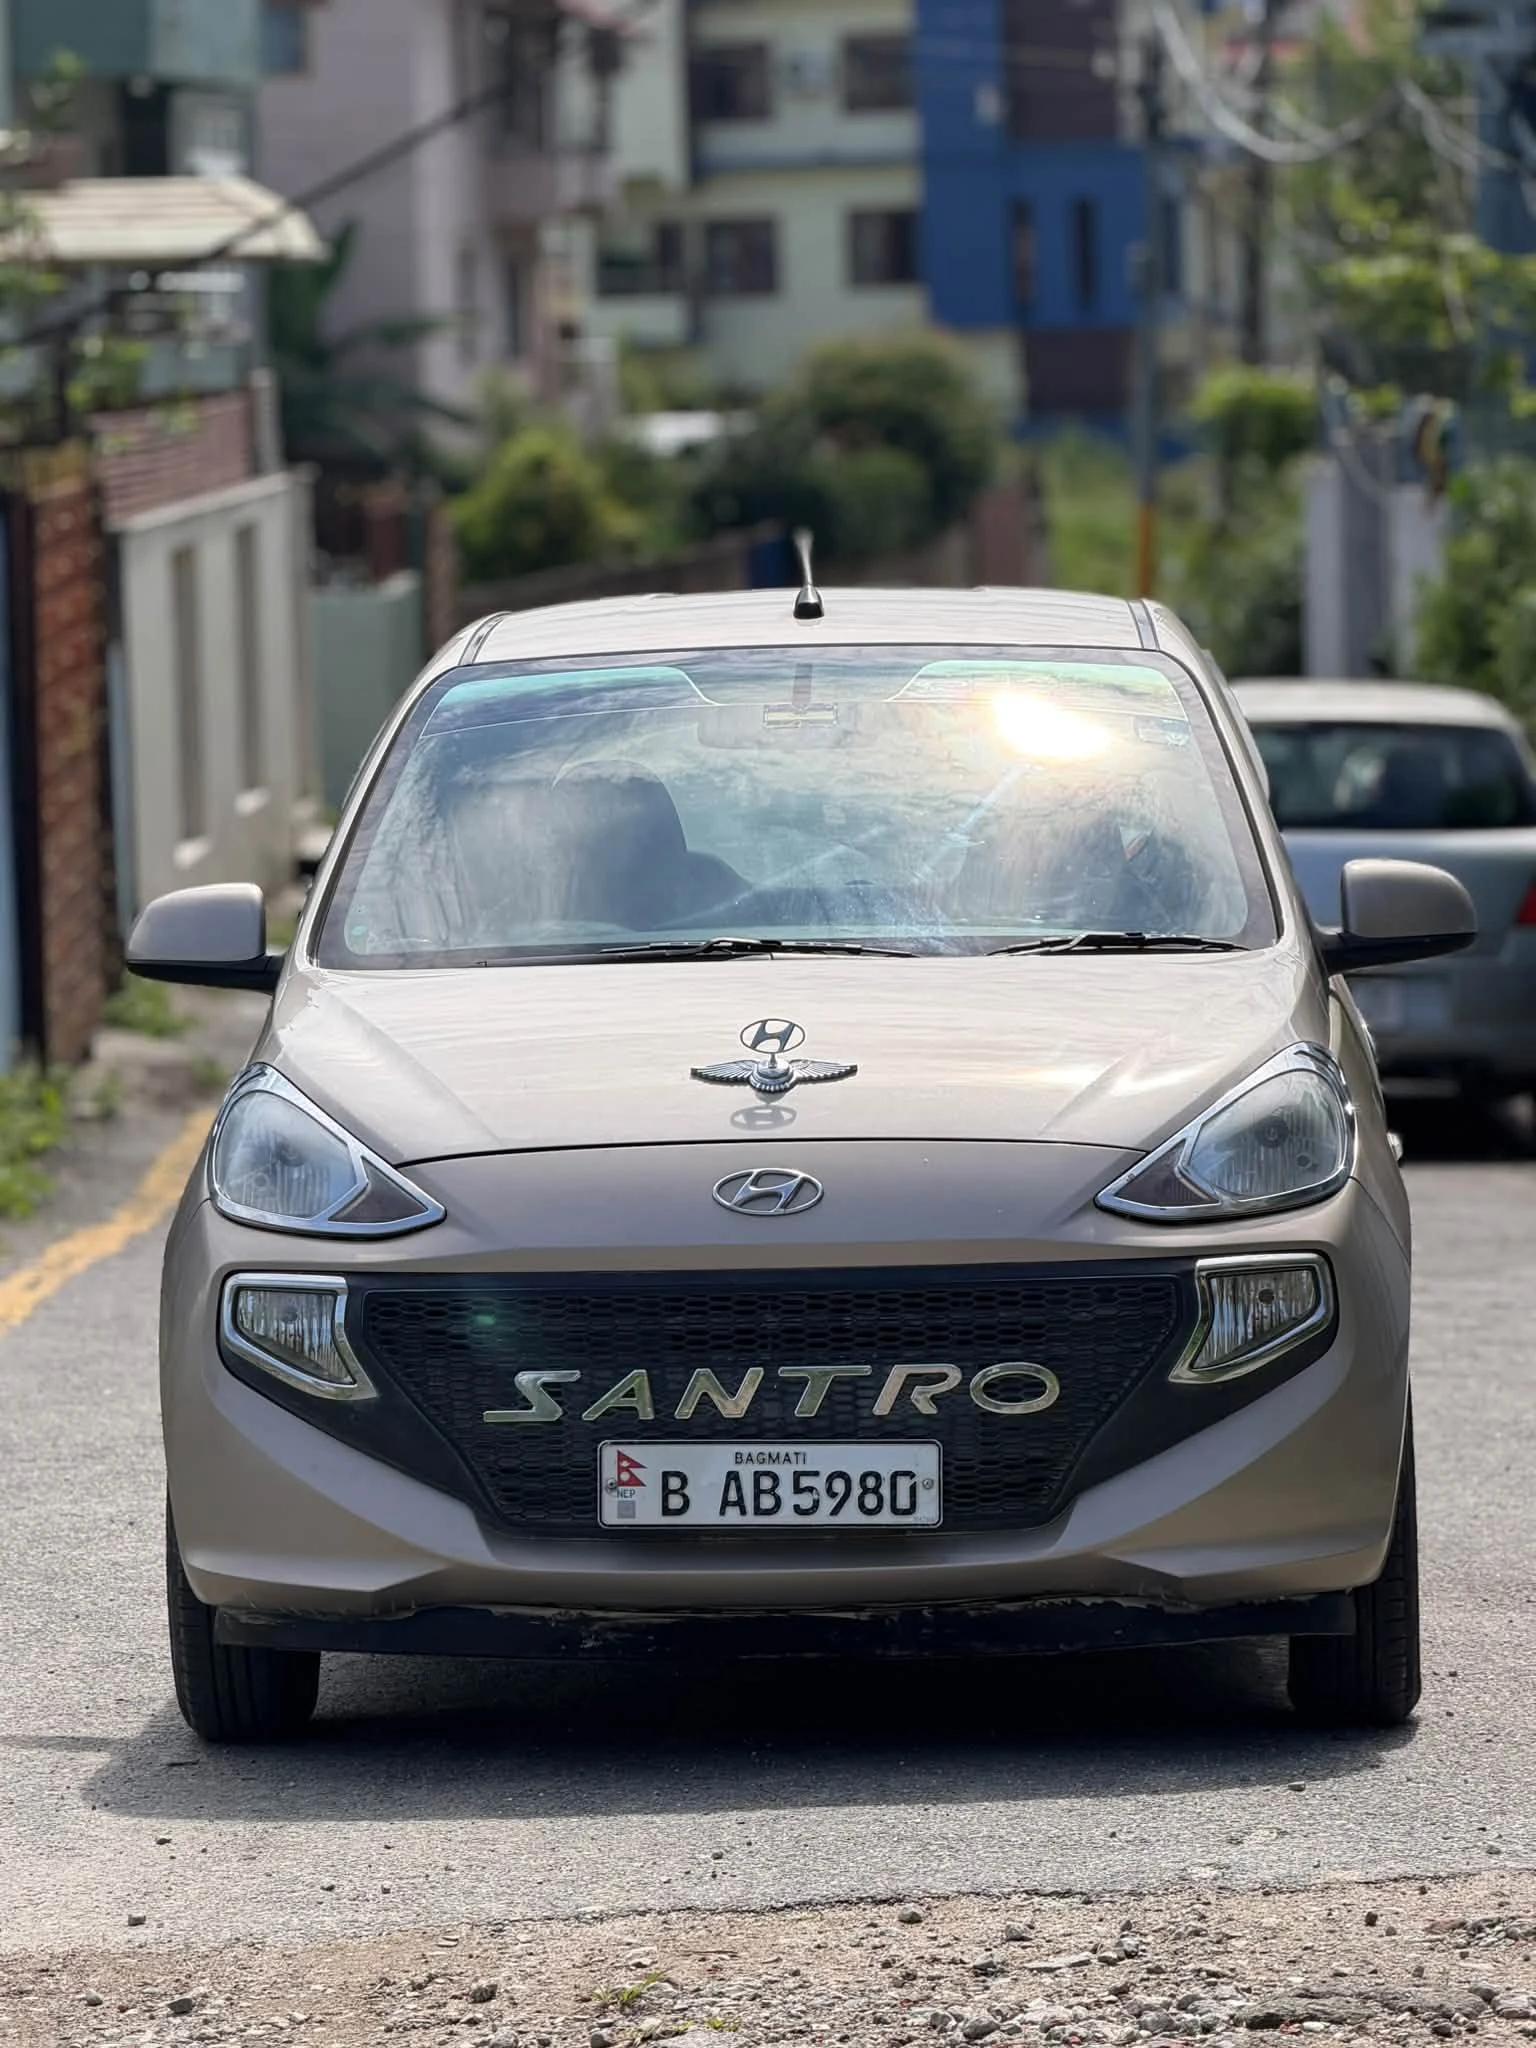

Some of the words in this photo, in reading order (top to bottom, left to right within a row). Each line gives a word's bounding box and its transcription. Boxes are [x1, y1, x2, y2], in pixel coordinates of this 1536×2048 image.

[483, 1362, 1060, 1423] SANTRO
[734, 1451, 807, 1465] BAGMATI
[616, 1488, 636, 1499] NEP
[661, 1470, 691, 1517] B
